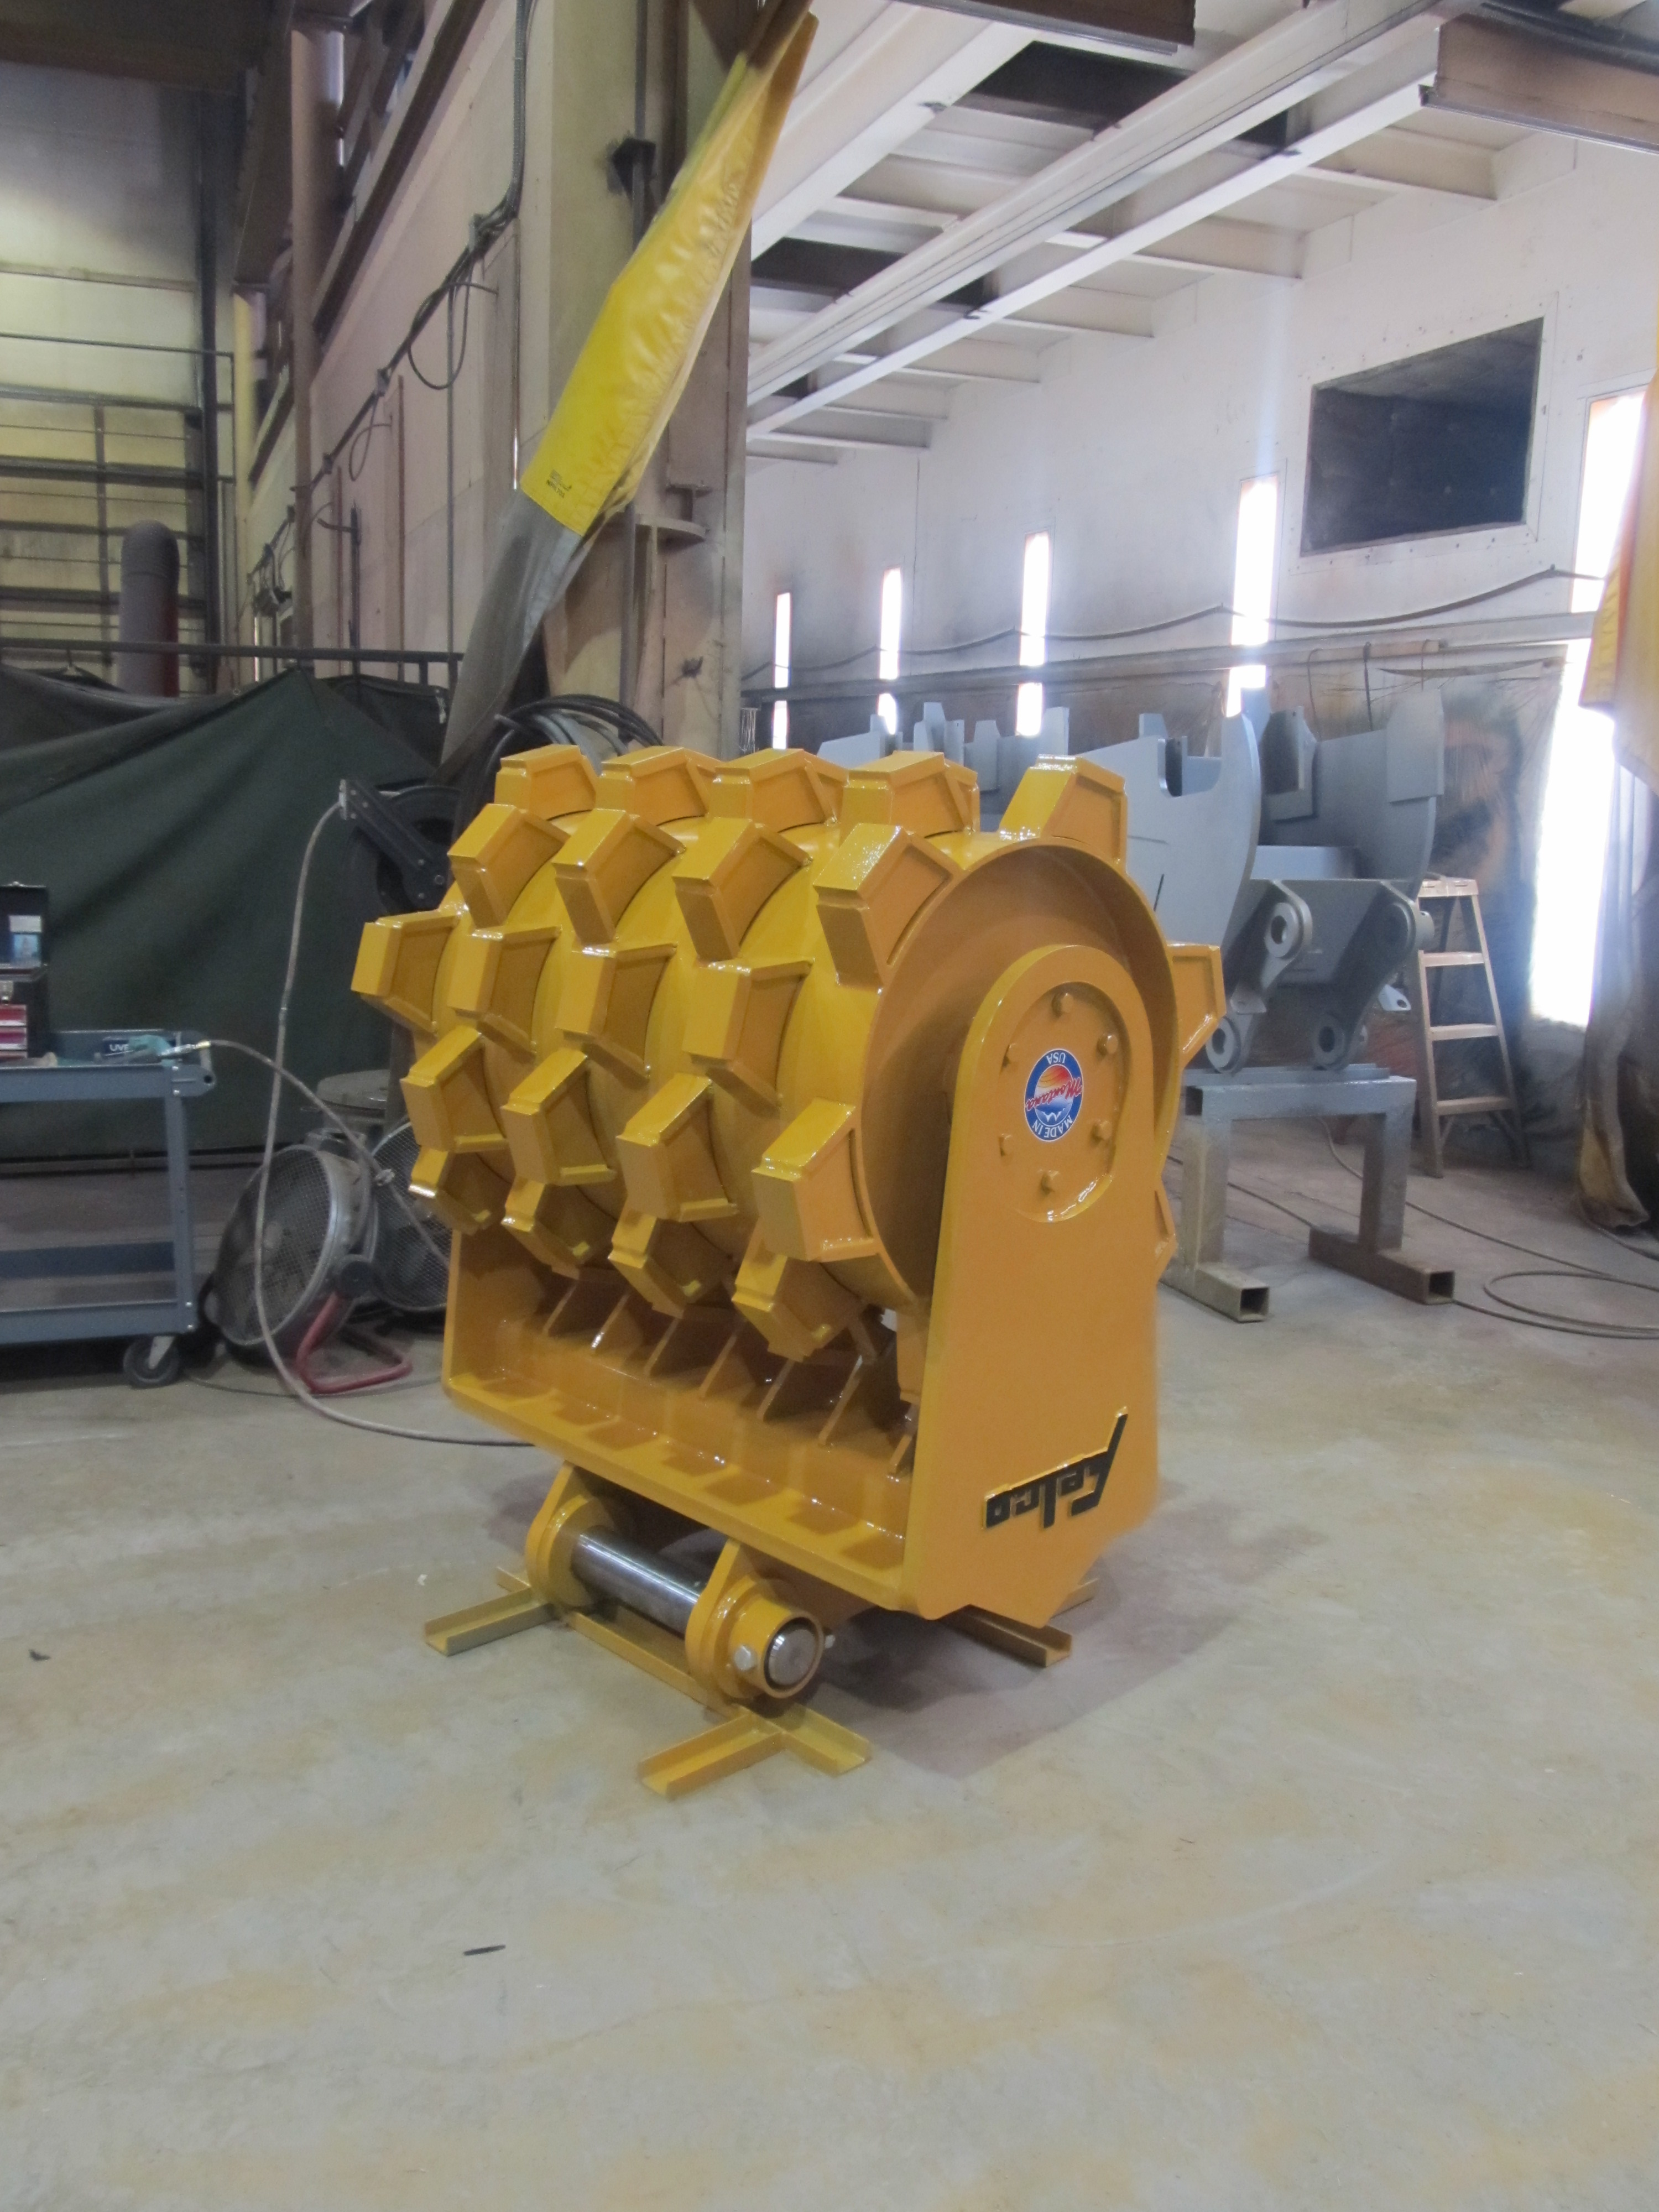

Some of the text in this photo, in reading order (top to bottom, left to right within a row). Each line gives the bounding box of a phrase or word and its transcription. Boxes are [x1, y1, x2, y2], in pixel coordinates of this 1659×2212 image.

[1046, 1052, 1066, 1065] USA
[1025, 1077, 1082, 1112] Montana
[1032, 1114, 1073, 1138] MADE IN
[984, 1412, 1128, 1529] Felco
